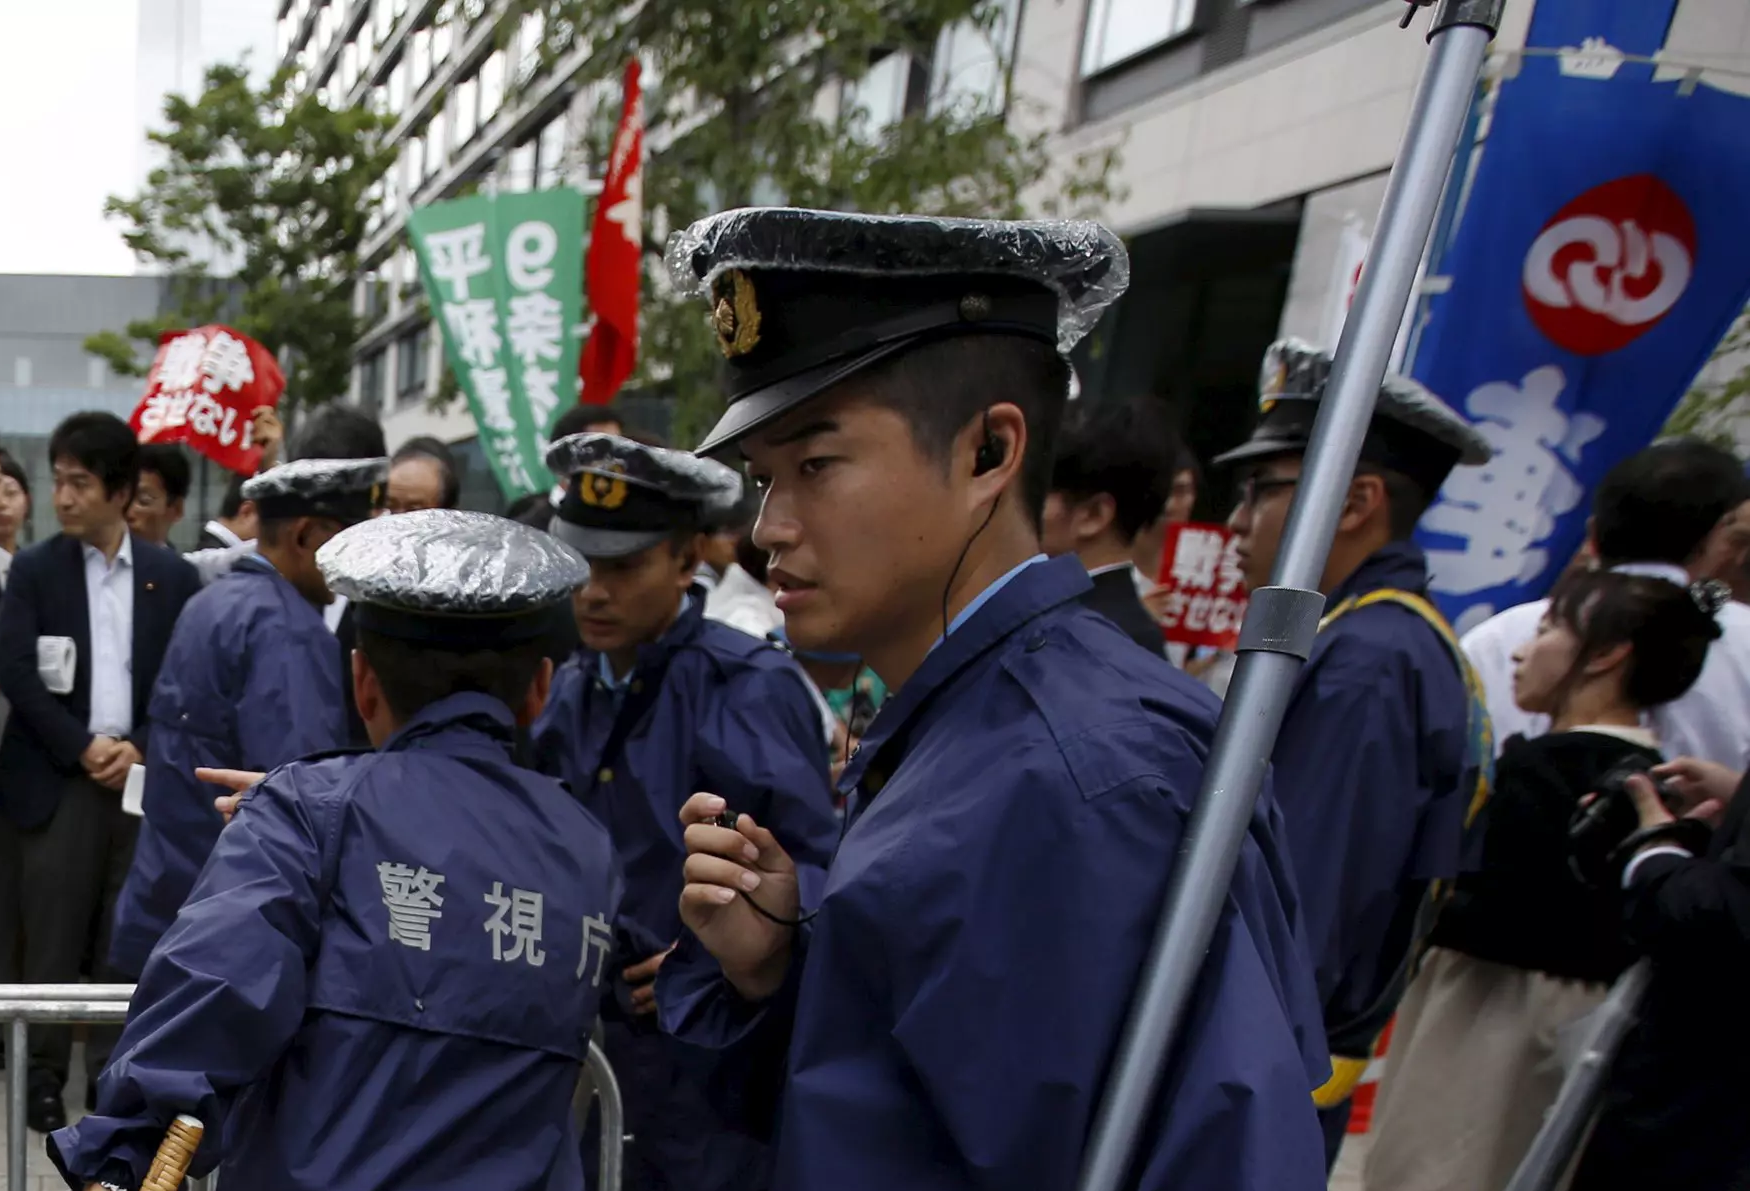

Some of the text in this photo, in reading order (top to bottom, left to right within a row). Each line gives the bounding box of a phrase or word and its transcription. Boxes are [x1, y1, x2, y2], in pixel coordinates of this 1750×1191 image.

[157, 331, 254, 393] 戦争
[376, 861, 612, 988] 警視庁
